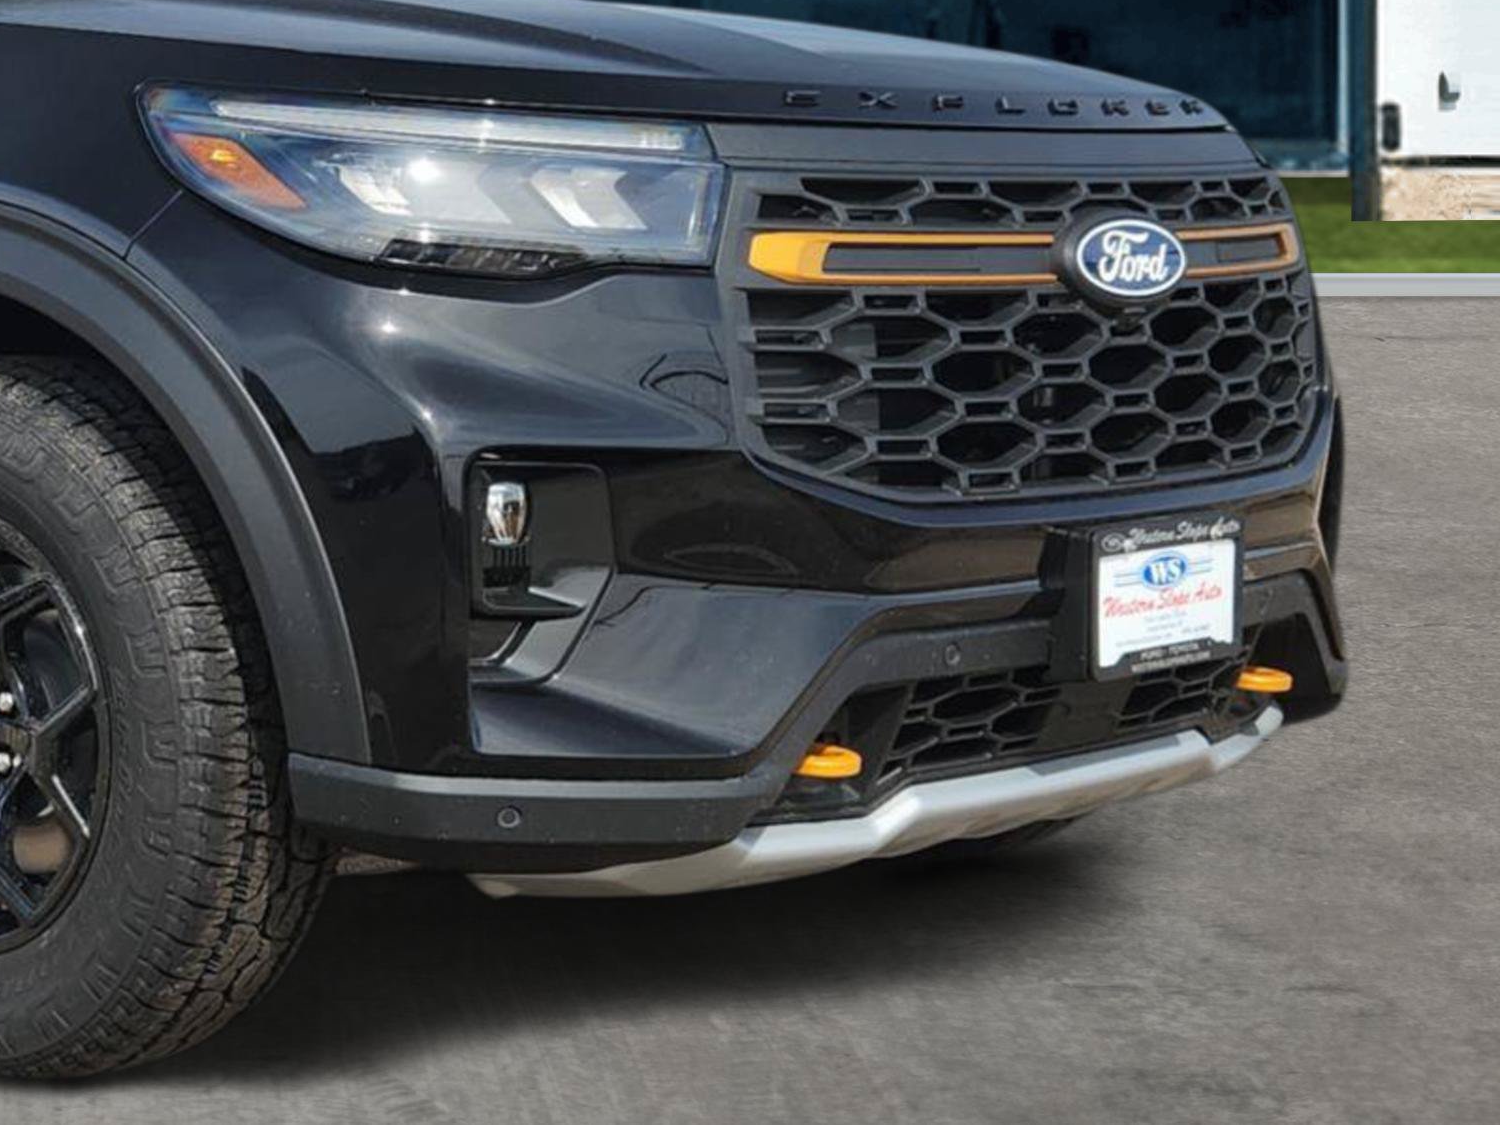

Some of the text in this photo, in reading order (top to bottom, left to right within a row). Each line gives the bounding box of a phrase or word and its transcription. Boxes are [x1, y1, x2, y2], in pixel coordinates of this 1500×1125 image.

[783, 89, 1204, 116] EXPLORER
[1098, 229, 1169, 282] Ford
[1150, 559, 1182, 586] WS
[1195, 581, 1223, 604] Auto
